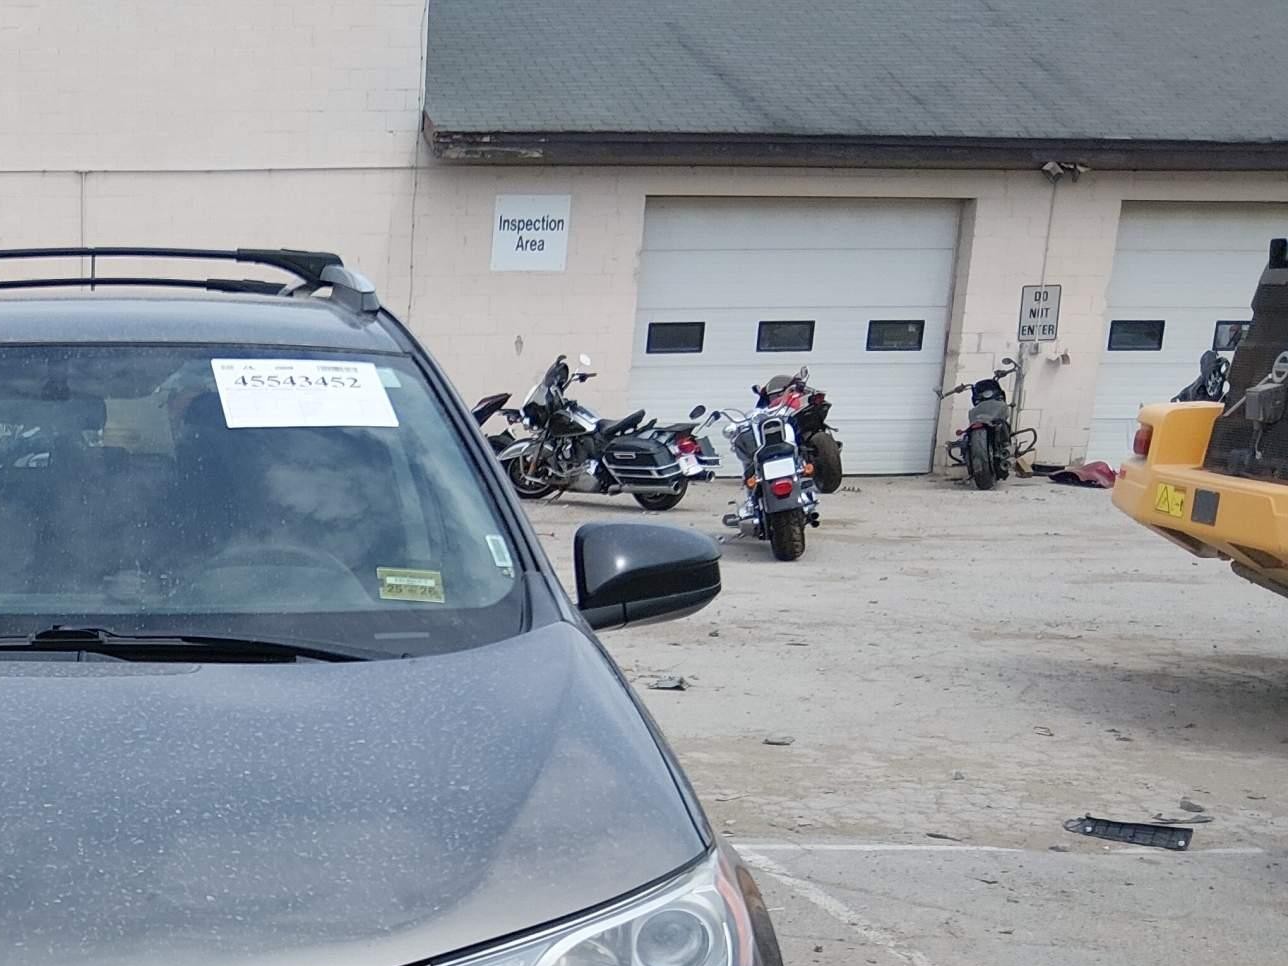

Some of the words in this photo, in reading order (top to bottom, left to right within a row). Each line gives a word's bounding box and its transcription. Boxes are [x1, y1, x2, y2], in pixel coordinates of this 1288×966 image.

[498, 214, 565, 235] Inspection
[515, 235, 545, 252] Area
[1033, 290, 1049, 302] DO
[1029, 307, 1051, 319] NOT
[234, 375, 362, 389] 45543452
